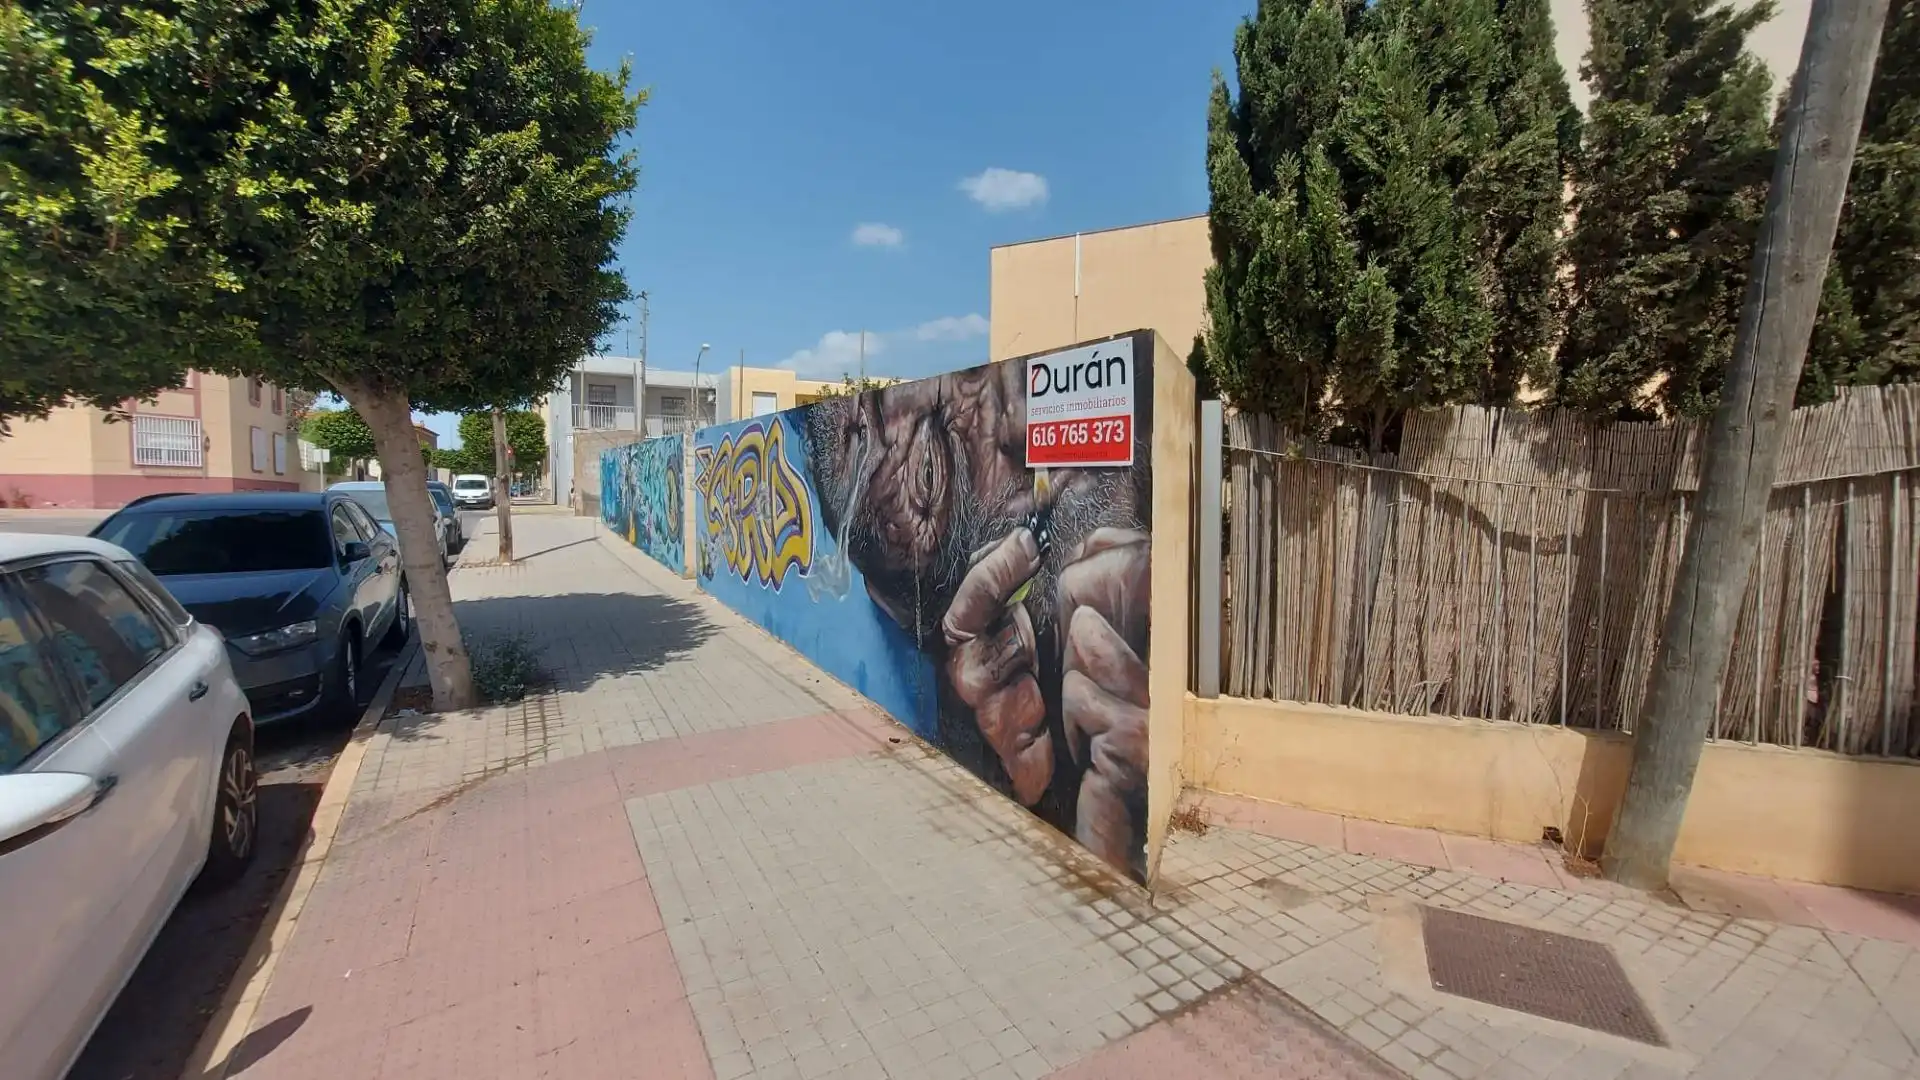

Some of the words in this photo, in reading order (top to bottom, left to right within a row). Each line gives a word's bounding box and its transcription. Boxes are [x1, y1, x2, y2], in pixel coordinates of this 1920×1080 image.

[1031, 351, 1126, 398] Durán
[1031, 404, 1065, 417] servicios
[1066, 396, 1126, 413] inmobiliarios
[1032, 425, 1056, 447] 616
[1060, 422, 1088, 445] 765
[1092, 420, 1125, 443] 373
